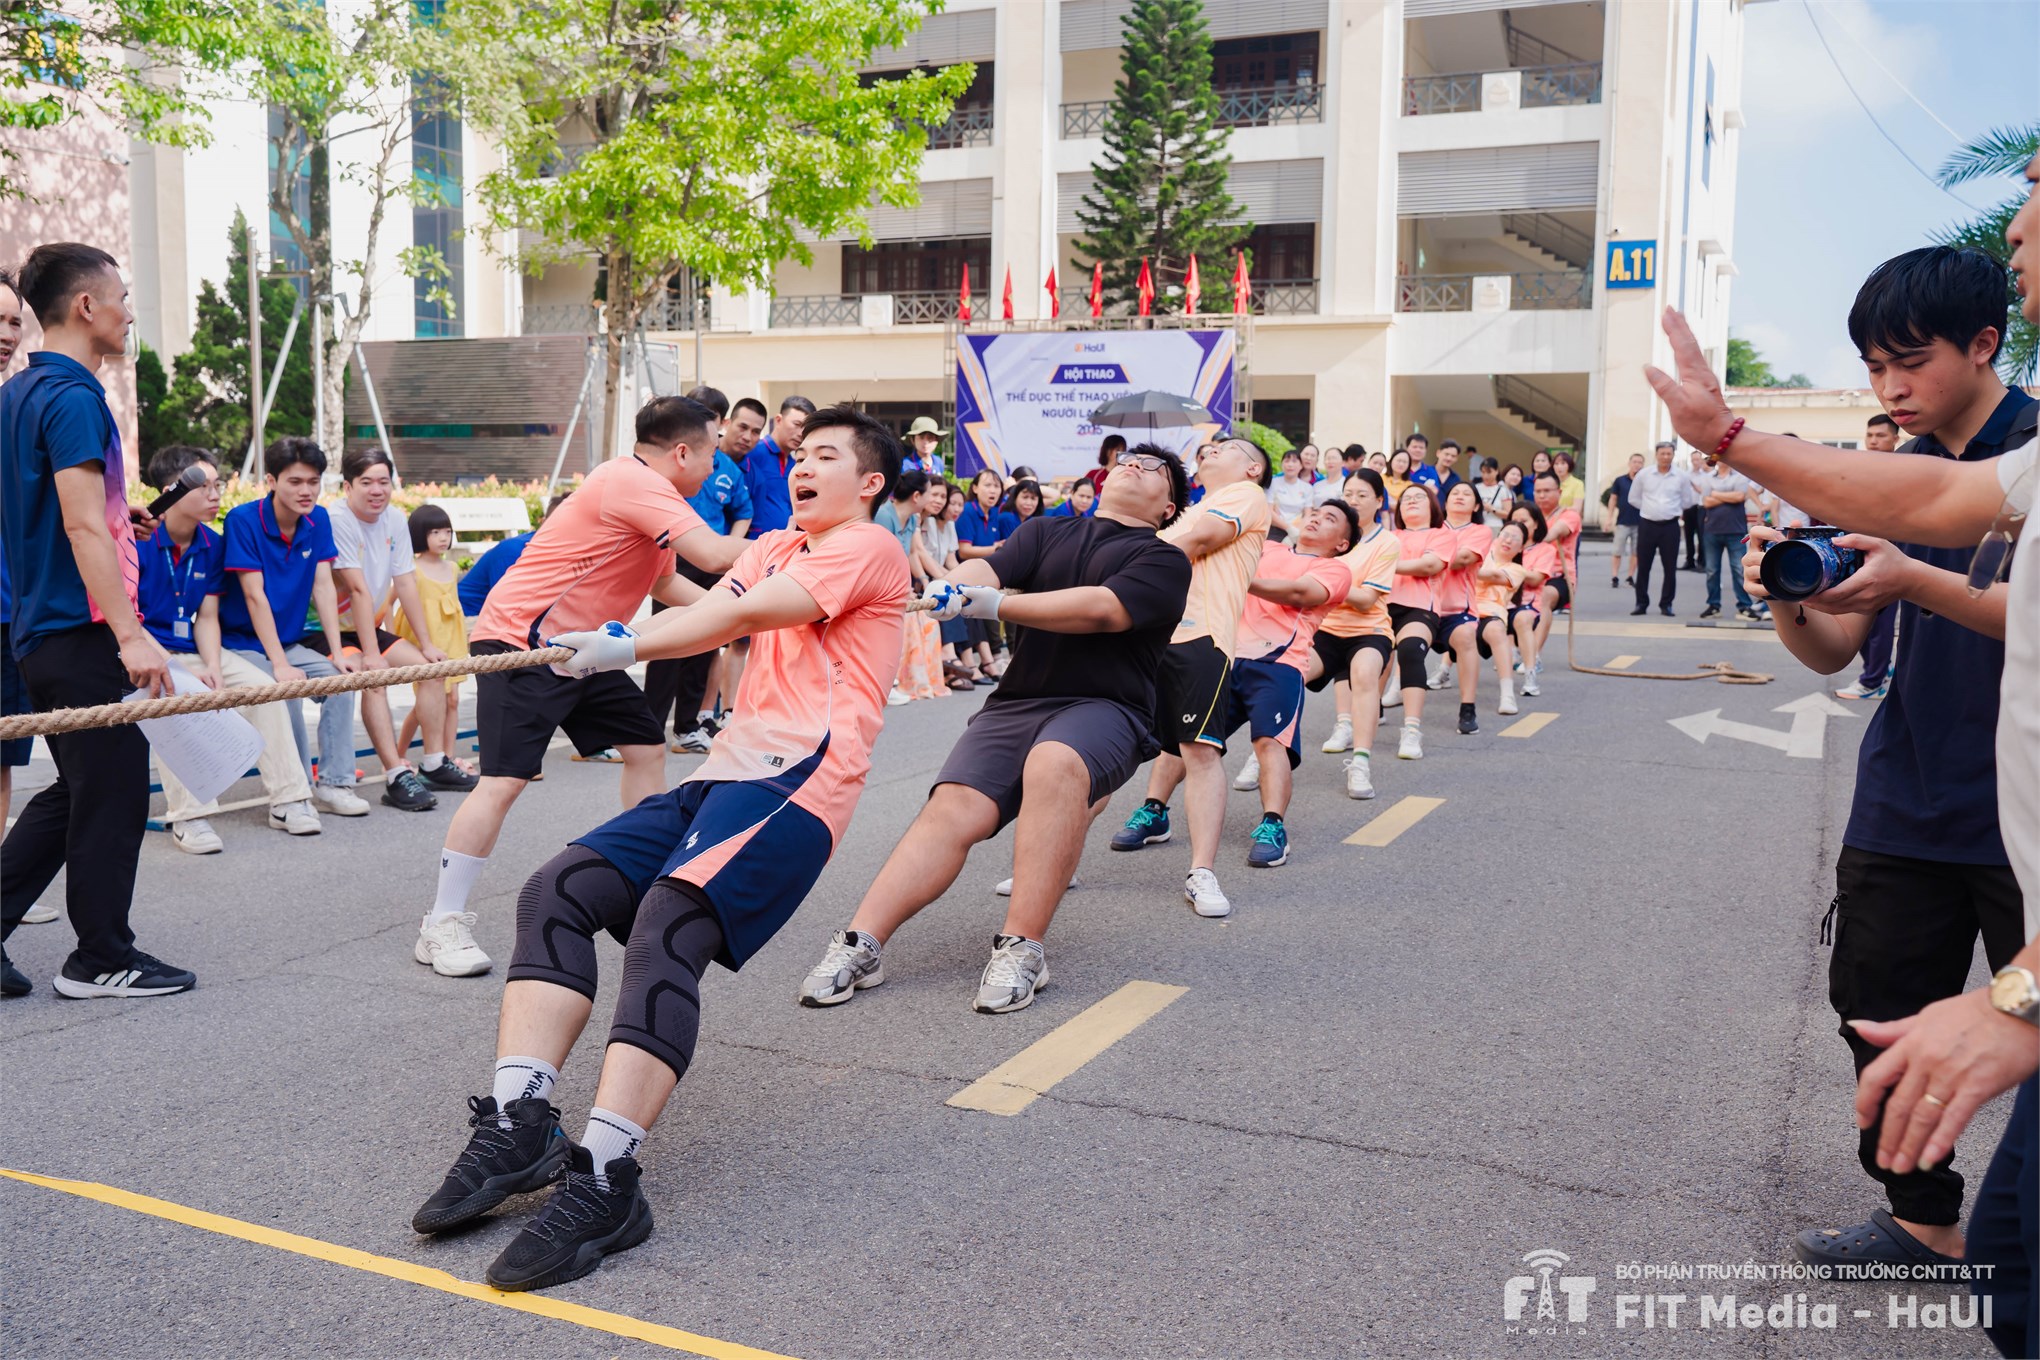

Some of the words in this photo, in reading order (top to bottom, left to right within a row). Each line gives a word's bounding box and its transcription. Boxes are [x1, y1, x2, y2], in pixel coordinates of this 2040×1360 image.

[1609, 247, 1654, 281] A.11
[1064, 367, 1083, 382] HỘI
[1085, 368, 1115, 379] THAO
[1029, 393, 1051, 405] DỤC
[1079, 392, 1109, 402] THAO
